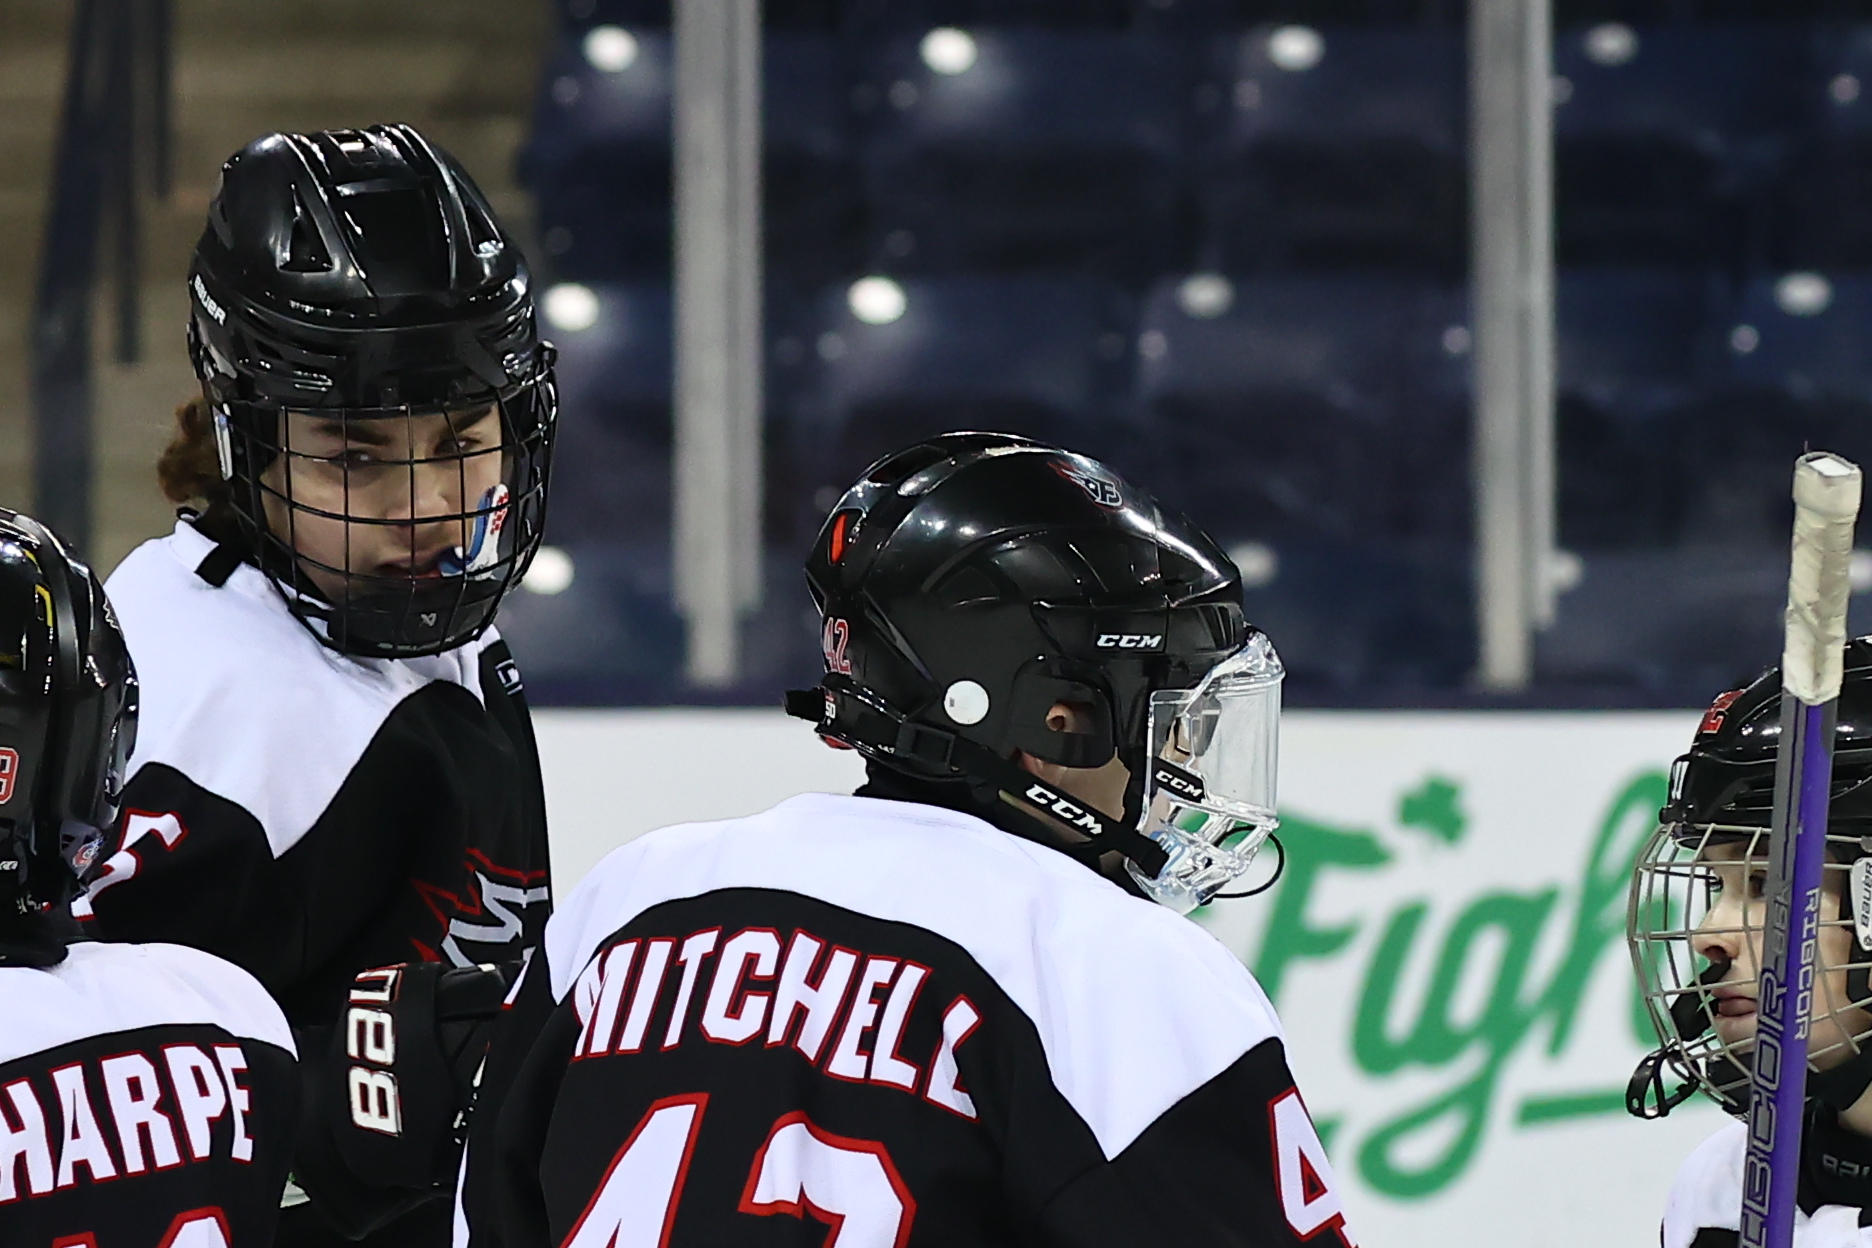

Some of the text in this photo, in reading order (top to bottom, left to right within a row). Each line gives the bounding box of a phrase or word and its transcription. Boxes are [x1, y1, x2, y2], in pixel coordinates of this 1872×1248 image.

[823, 616, 852, 675] 42
[1097, 633, 1162, 650] CCM
[1025, 782, 1103, 836] CCM
[1155, 769, 1203, 797] CCM
[1794, 886, 1821, 1041] RIBCOR
[570, 924, 985, 1122] MITCHELL
